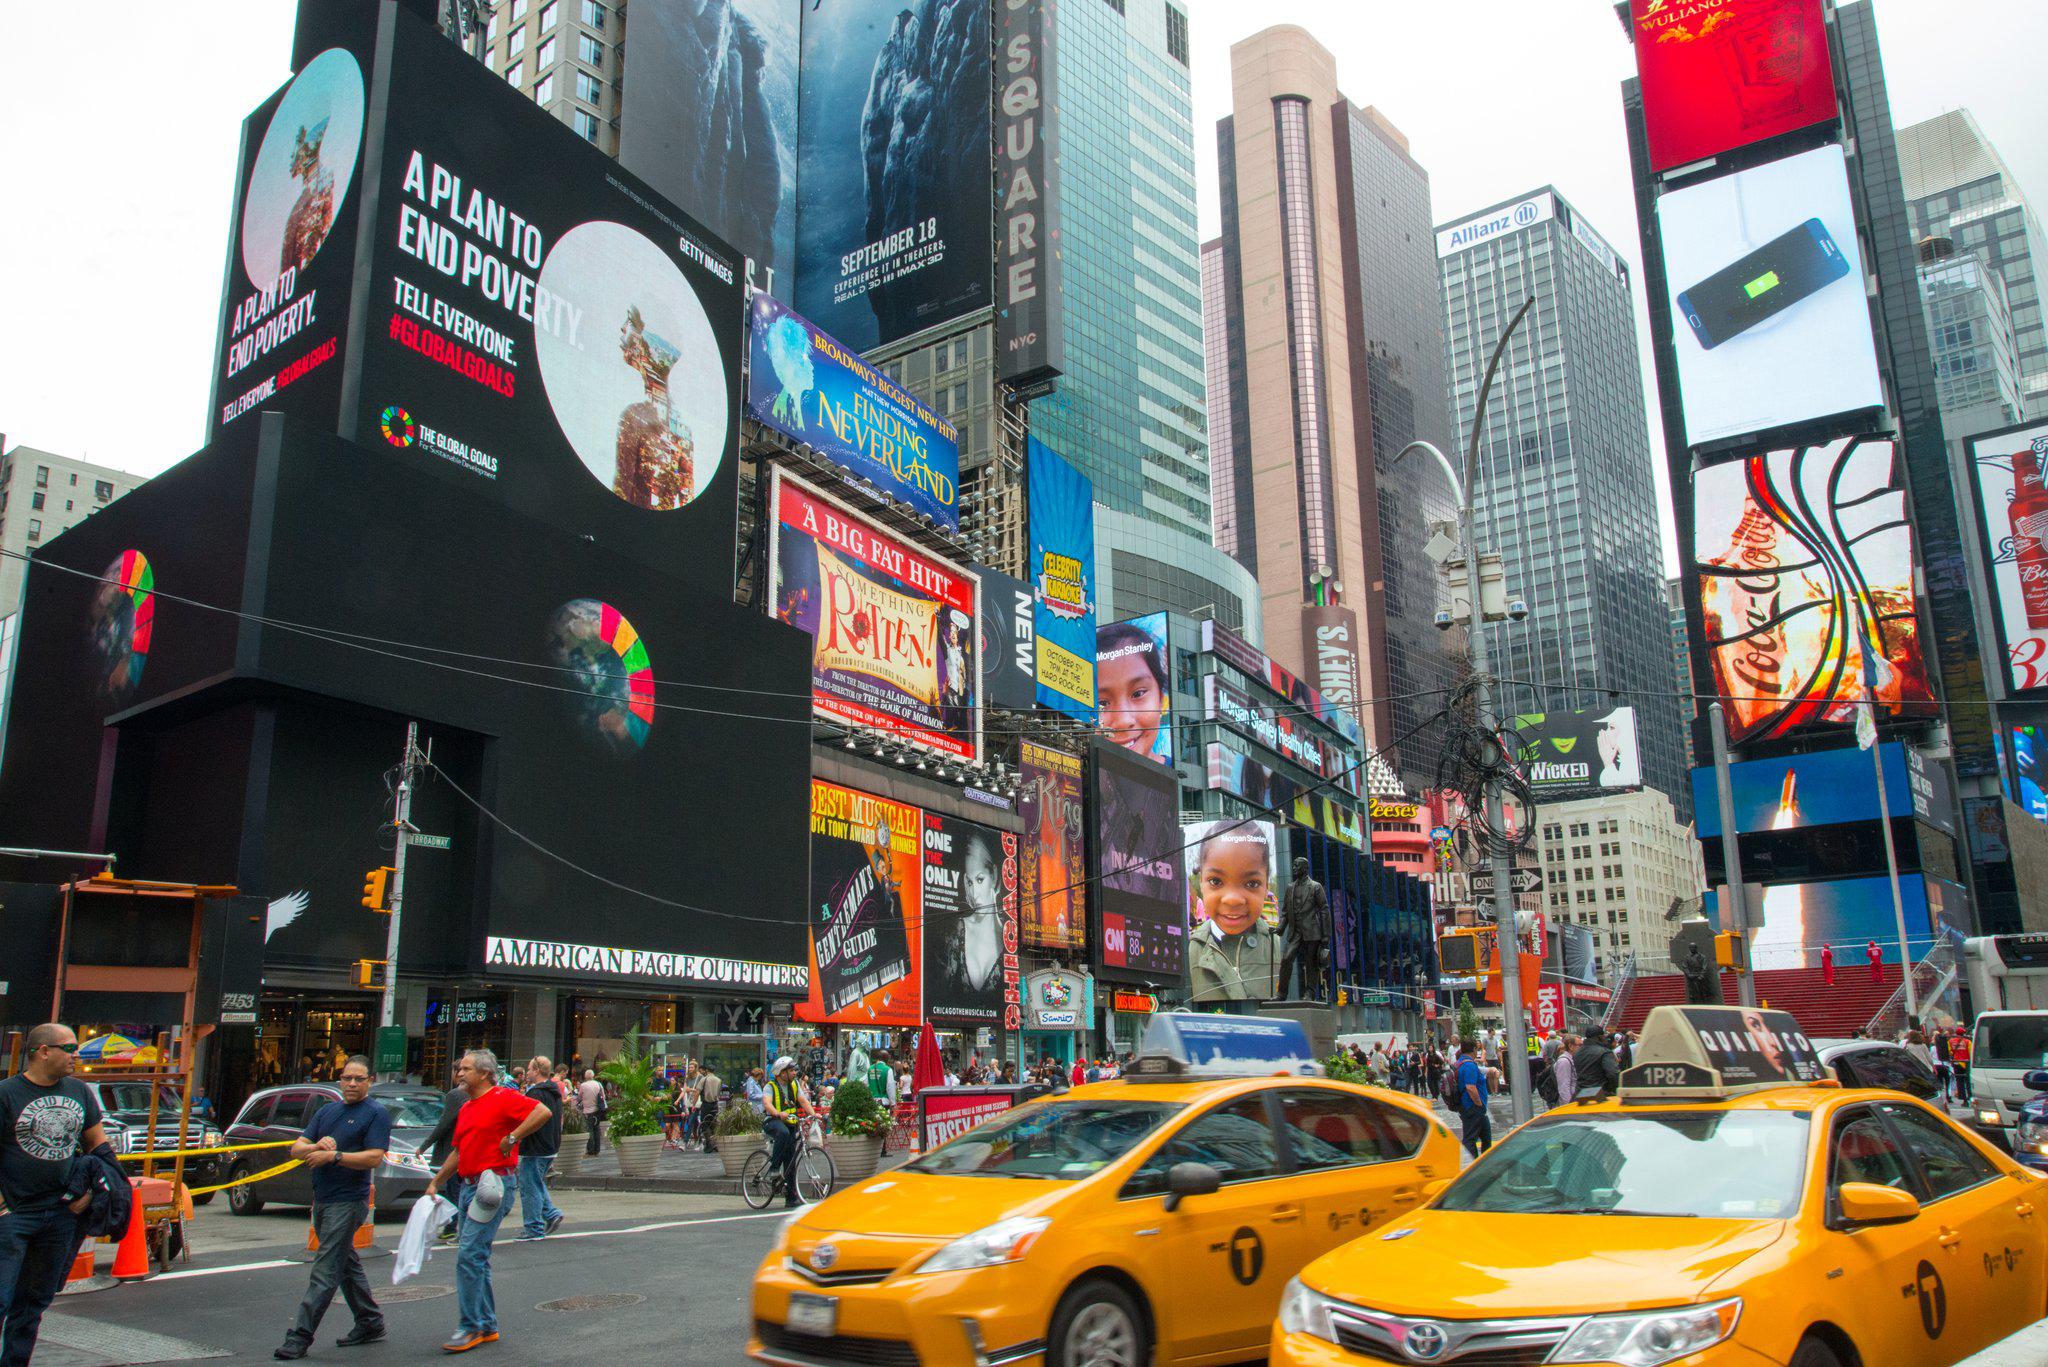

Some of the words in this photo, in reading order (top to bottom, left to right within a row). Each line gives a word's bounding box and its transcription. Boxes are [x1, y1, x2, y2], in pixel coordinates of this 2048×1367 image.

[1641, 0, 1735, 31] WULIANG
[1002, 33, 1040, 305] SQUARE
[402, 150, 426, 202] A
[430, 162, 507, 249] PLAN
[509, 211, 543, 269] TO
[841, 226, 914, 277] SEPTEMBER
[918, 217, 937, 243] 18
[1450, 215, 1511, 248] Allianz
[398, 202, 458, 277] END
[461, 240, 584, 351] POVERTY.
[680, 236, 704, 265] GETTY
[704, 254, 733, 286] IMAGES
[834, 266, 879, 294] EXPERIENCE
[882, 262, 890, 274] IT
[892, 258, 901, 270] IN
[903, 239, 946, 266] THEATERS,
[868, 278, 881, 290] 3D
[897, 260, 926, 278] IMAX
[927, 252, 944, 266] 3D
[232, 304, 243, 338] A
[243, 280, 279, 331] PLAN
[279, 265, 297, 304] TO
[227, 333, 254, 379] END
[253, 289, 317, 361] POVERTY.
[393, 276, 431, 321] TELL
[433, 298, 518, 367] EVERYONE.
[389, 313, 516, 399] #GLOBALGOALS
[1009, 332, 1037, 351] NYC
[815, 333, 877, 387] BROADWAY'S
[878, 377, 916, 413] BIGGEST
[917, 405, 938, 429] NEW
[938, 421, 958, 443] HIT!
[861, 385, 890, 409] MATTHEW
[889, 402, 918, 429] MORRISON
[222, 401, 239, 425] TELL
[853, 392, 927, 460] FINDING
[419, 424, 436, 445] THE
[437, 431, 470, 461] GLOBAL
[470, 447, 499, 472] GOALS
[817, 391, 955, 506] NEVERLAND
[871, 537, 905, 577] FAT
[1043, 551, 1082, 583] CELEBRITY
[836, 563, 925, 618] SOMETHING
[1046, 577, 1081, 604] KARAOKE
[1730, 508, 1782, 694] Coca-Cola
[1015, 590, 1034, 678] NEW
[1096, 648, 1125, 662] Morgan
[1124, 642, 1154, 657] Stanley
[1046, 648, 1075, 668] OCTOBER
[1316, 625, 1353, 720] SHEY'S
[832, 670, 846, 684] FROM
[886, 688, 919, 709] ALADDIN
[1041, 669, 1058, 683] HARD
[1058, 677, 1075, 691] ROCK
[1075, 686, 1090, 699] CAFE
[862, 693, 879, 707] THE
[880, 697, 901, 714] BOOK
[901, 707, 911, 719] OF
[1219, 690, 1250, 726] Morgan
[1250, 709, 1277, 742] Stanley
[850, 793, 917, 838] MUSICAL!
[925, 814, 943, 830] THE
[1031, 775, 1083, 841] King
[415, 836, 449, 848] BROADWAY
[827, 819, 849, 840] TONY
[849, 824, 876, 845] AWARD
[890, 834, 917, 855] WINNER
[925, 829, 952, 853] ONE
[1221, 835, 1247, 844] Morgan
[1247, 835, 1267, 845] Stanley
[925, 849, 943, 865] THE
[925, 864, 960, 889] ONLY
[1510, 875, 1532, 886] WAY
[815, 864, 875, 969] GENTLEMAN'S
[821, 903, 832, 921] A
[1002, 831, 1021, 1030] CHICAGO
[842, 927, 878, 959] GUIDE
[1104, 927, 1125, 952] CNN
[1129, 938, 1141, 957] 88
[490, 938, 624, 975] AMERICAN
[630, 950, 696, 979] EAGLE
[700, 957, 809, 987] OUTFITTERS
[932, 1006, 997, 1018] CHICAGOTHEMUSICAL.COM
[1042, 1013, 1073, 1023] Sanrio
[1538, 986, 1558, 1027] tkts
[850, 1032, 891, 1049] GAND
[1700, 1029, 1810, 1052] QUANTICO
[1644, 1068, 1686, 1085] 1P82
[16, 1096, 60, 1127] RANCID
